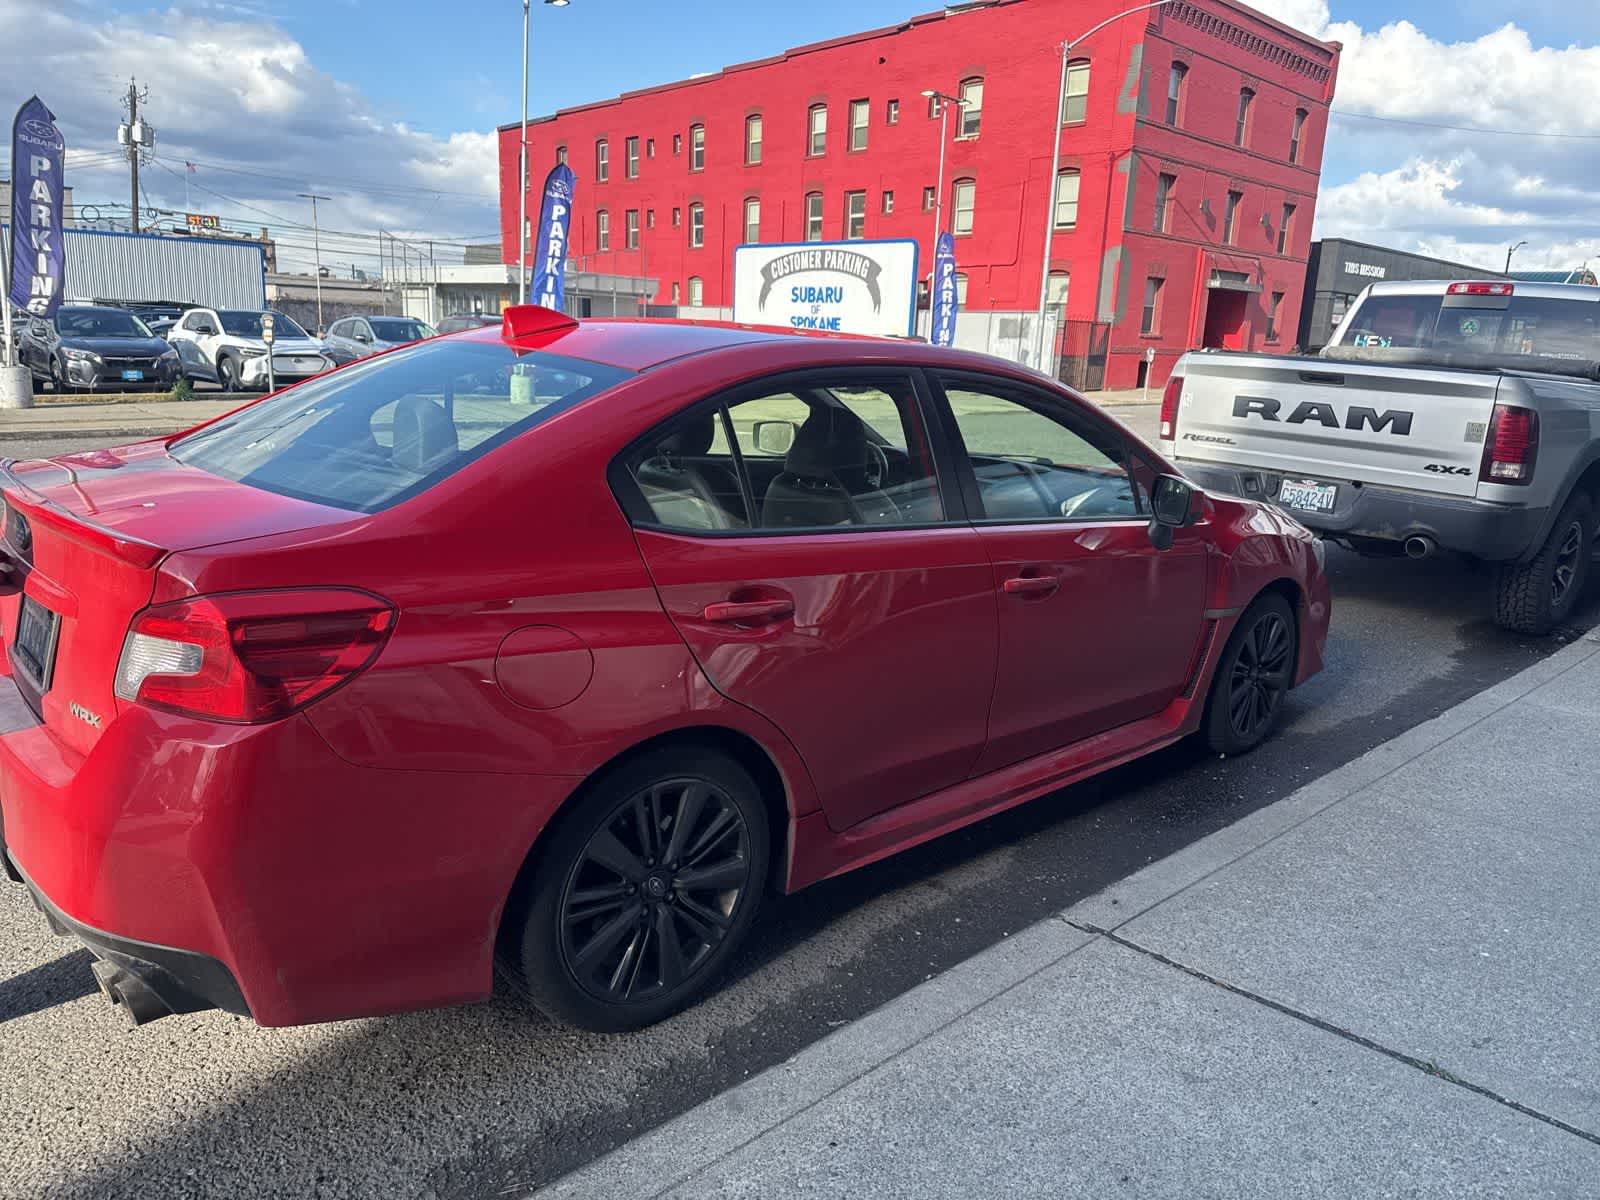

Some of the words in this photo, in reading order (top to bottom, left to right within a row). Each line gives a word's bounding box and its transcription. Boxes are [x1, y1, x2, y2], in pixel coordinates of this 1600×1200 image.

[26, 154, 53, 316] PARKING
[541, 204, 567, 311] PARKIN
[770, 250, 821, 279] CUSTOMER
[824, 250, 870, 279] PARKING
[791, 286, 843, 303] SUBARU
[938, 263, 954, 346] PARKIN
[790, 315, 842, 331] SPOKANE
[811, 304, 821, 315] OF
[1232, 395, 1414, 436] RAM
[1182, 433, 1237, 445] REBEL
[69, 700, 102, 729] WRX
